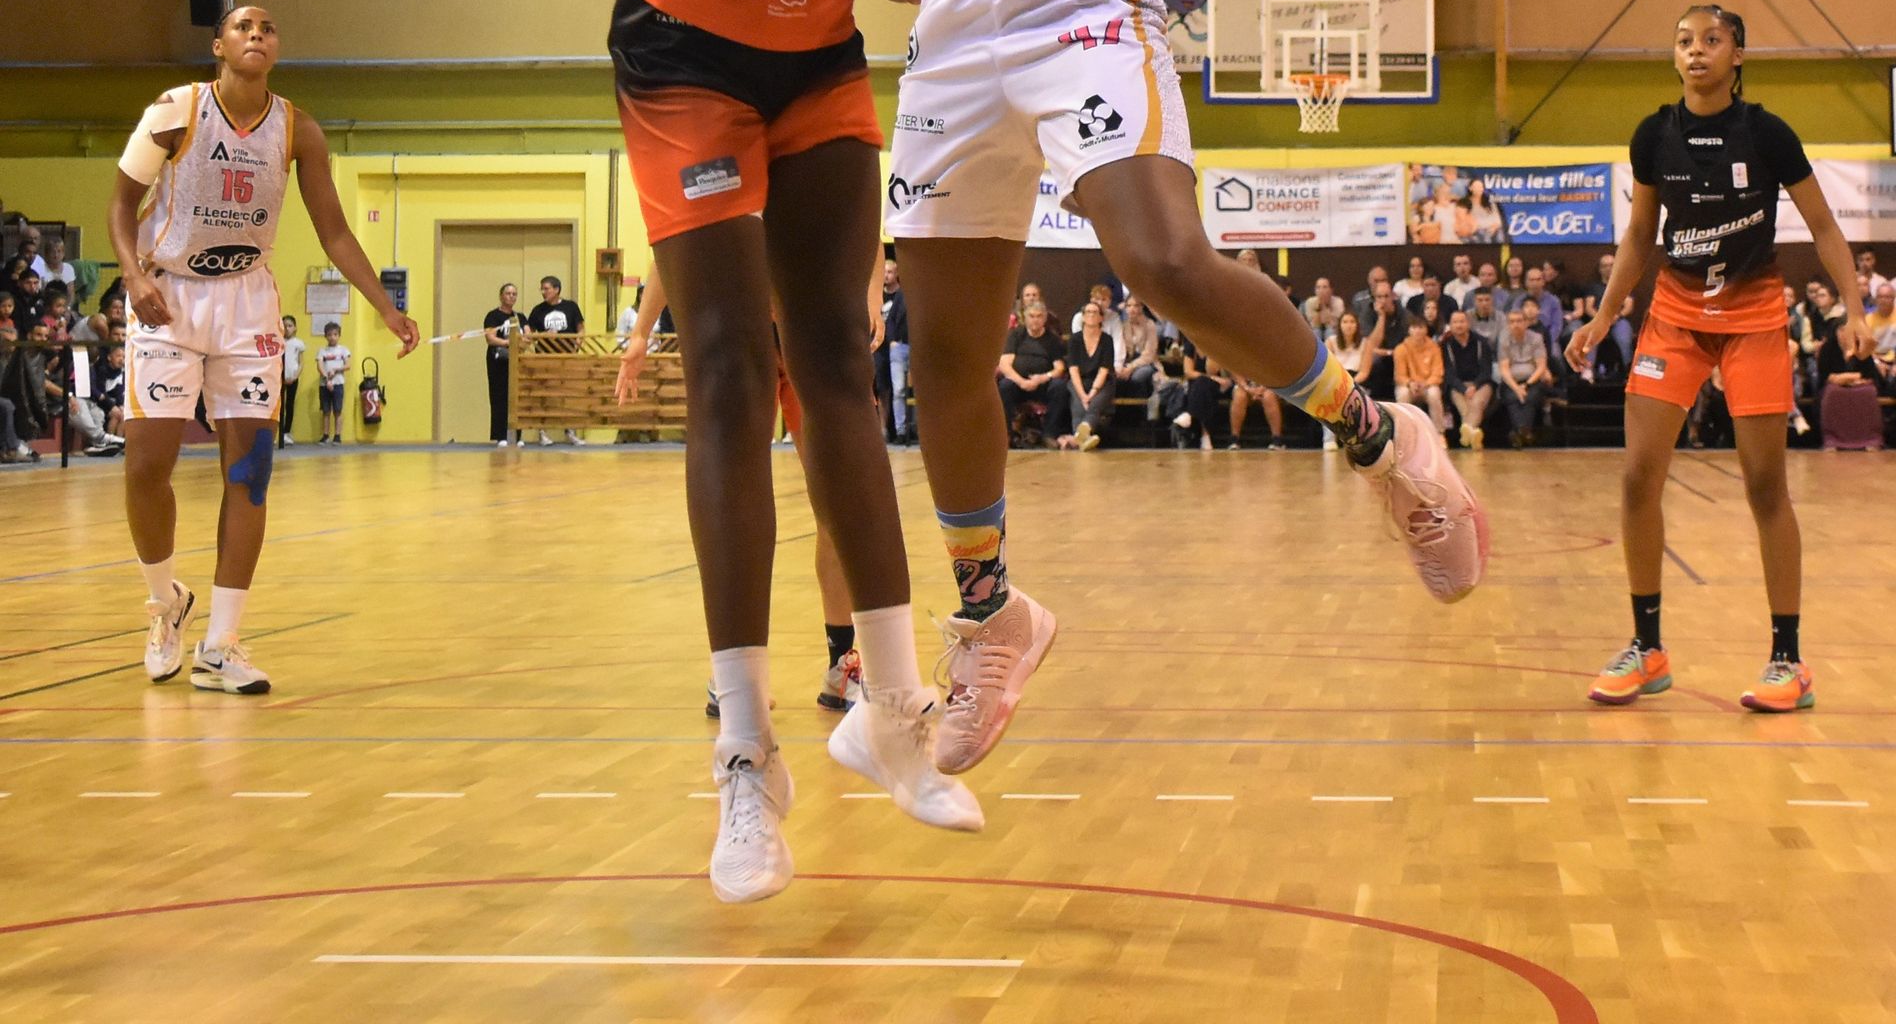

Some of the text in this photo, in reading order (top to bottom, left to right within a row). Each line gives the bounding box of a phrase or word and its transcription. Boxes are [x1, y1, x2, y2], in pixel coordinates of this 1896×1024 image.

[232, 148, 249, 157] Ville
[221, 168, 255, 204] 15
[1484, 170, 1605, 190] Vive les filles
[1256, 187, 1321, 200] FRANCE
[1256, 200, 1321, 213] CONFORT
[1508, 209, 1595, 237] BOUBET
[1702, 262, 1727, 298] 5
[254, 333, 282, 358] 15
